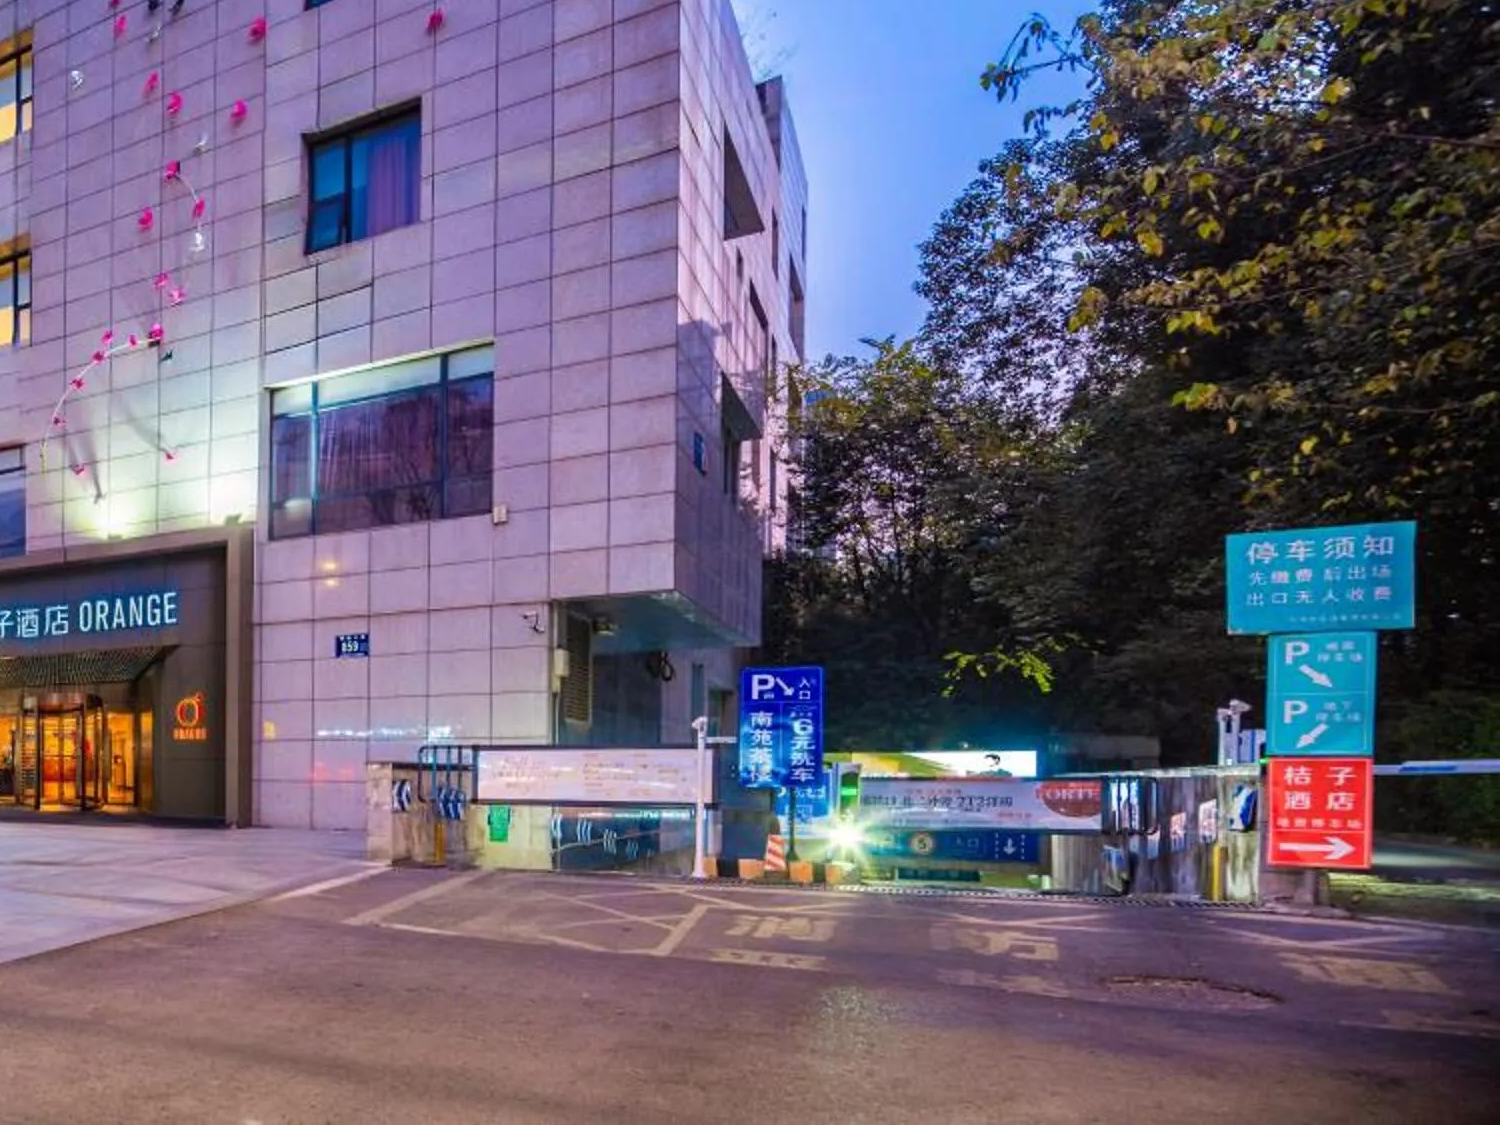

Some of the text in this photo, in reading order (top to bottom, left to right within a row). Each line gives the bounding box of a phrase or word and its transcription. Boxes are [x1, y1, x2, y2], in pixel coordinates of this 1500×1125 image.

[1246, 535, 1395, 565] 停车须知
[1246, 586, 1393, 607] 出口无人收费
[78, 591, 178, 633] ORANGE
[1284, 641, 1310, 665] P
[751, 674, 775, 700] P
[798, 677, 812, 700] 入口
[1283, 700, 1309, 724] P
[1283, 765, 1357, 787] 桔子
[1283, 790, 1355, 812] 酒店
